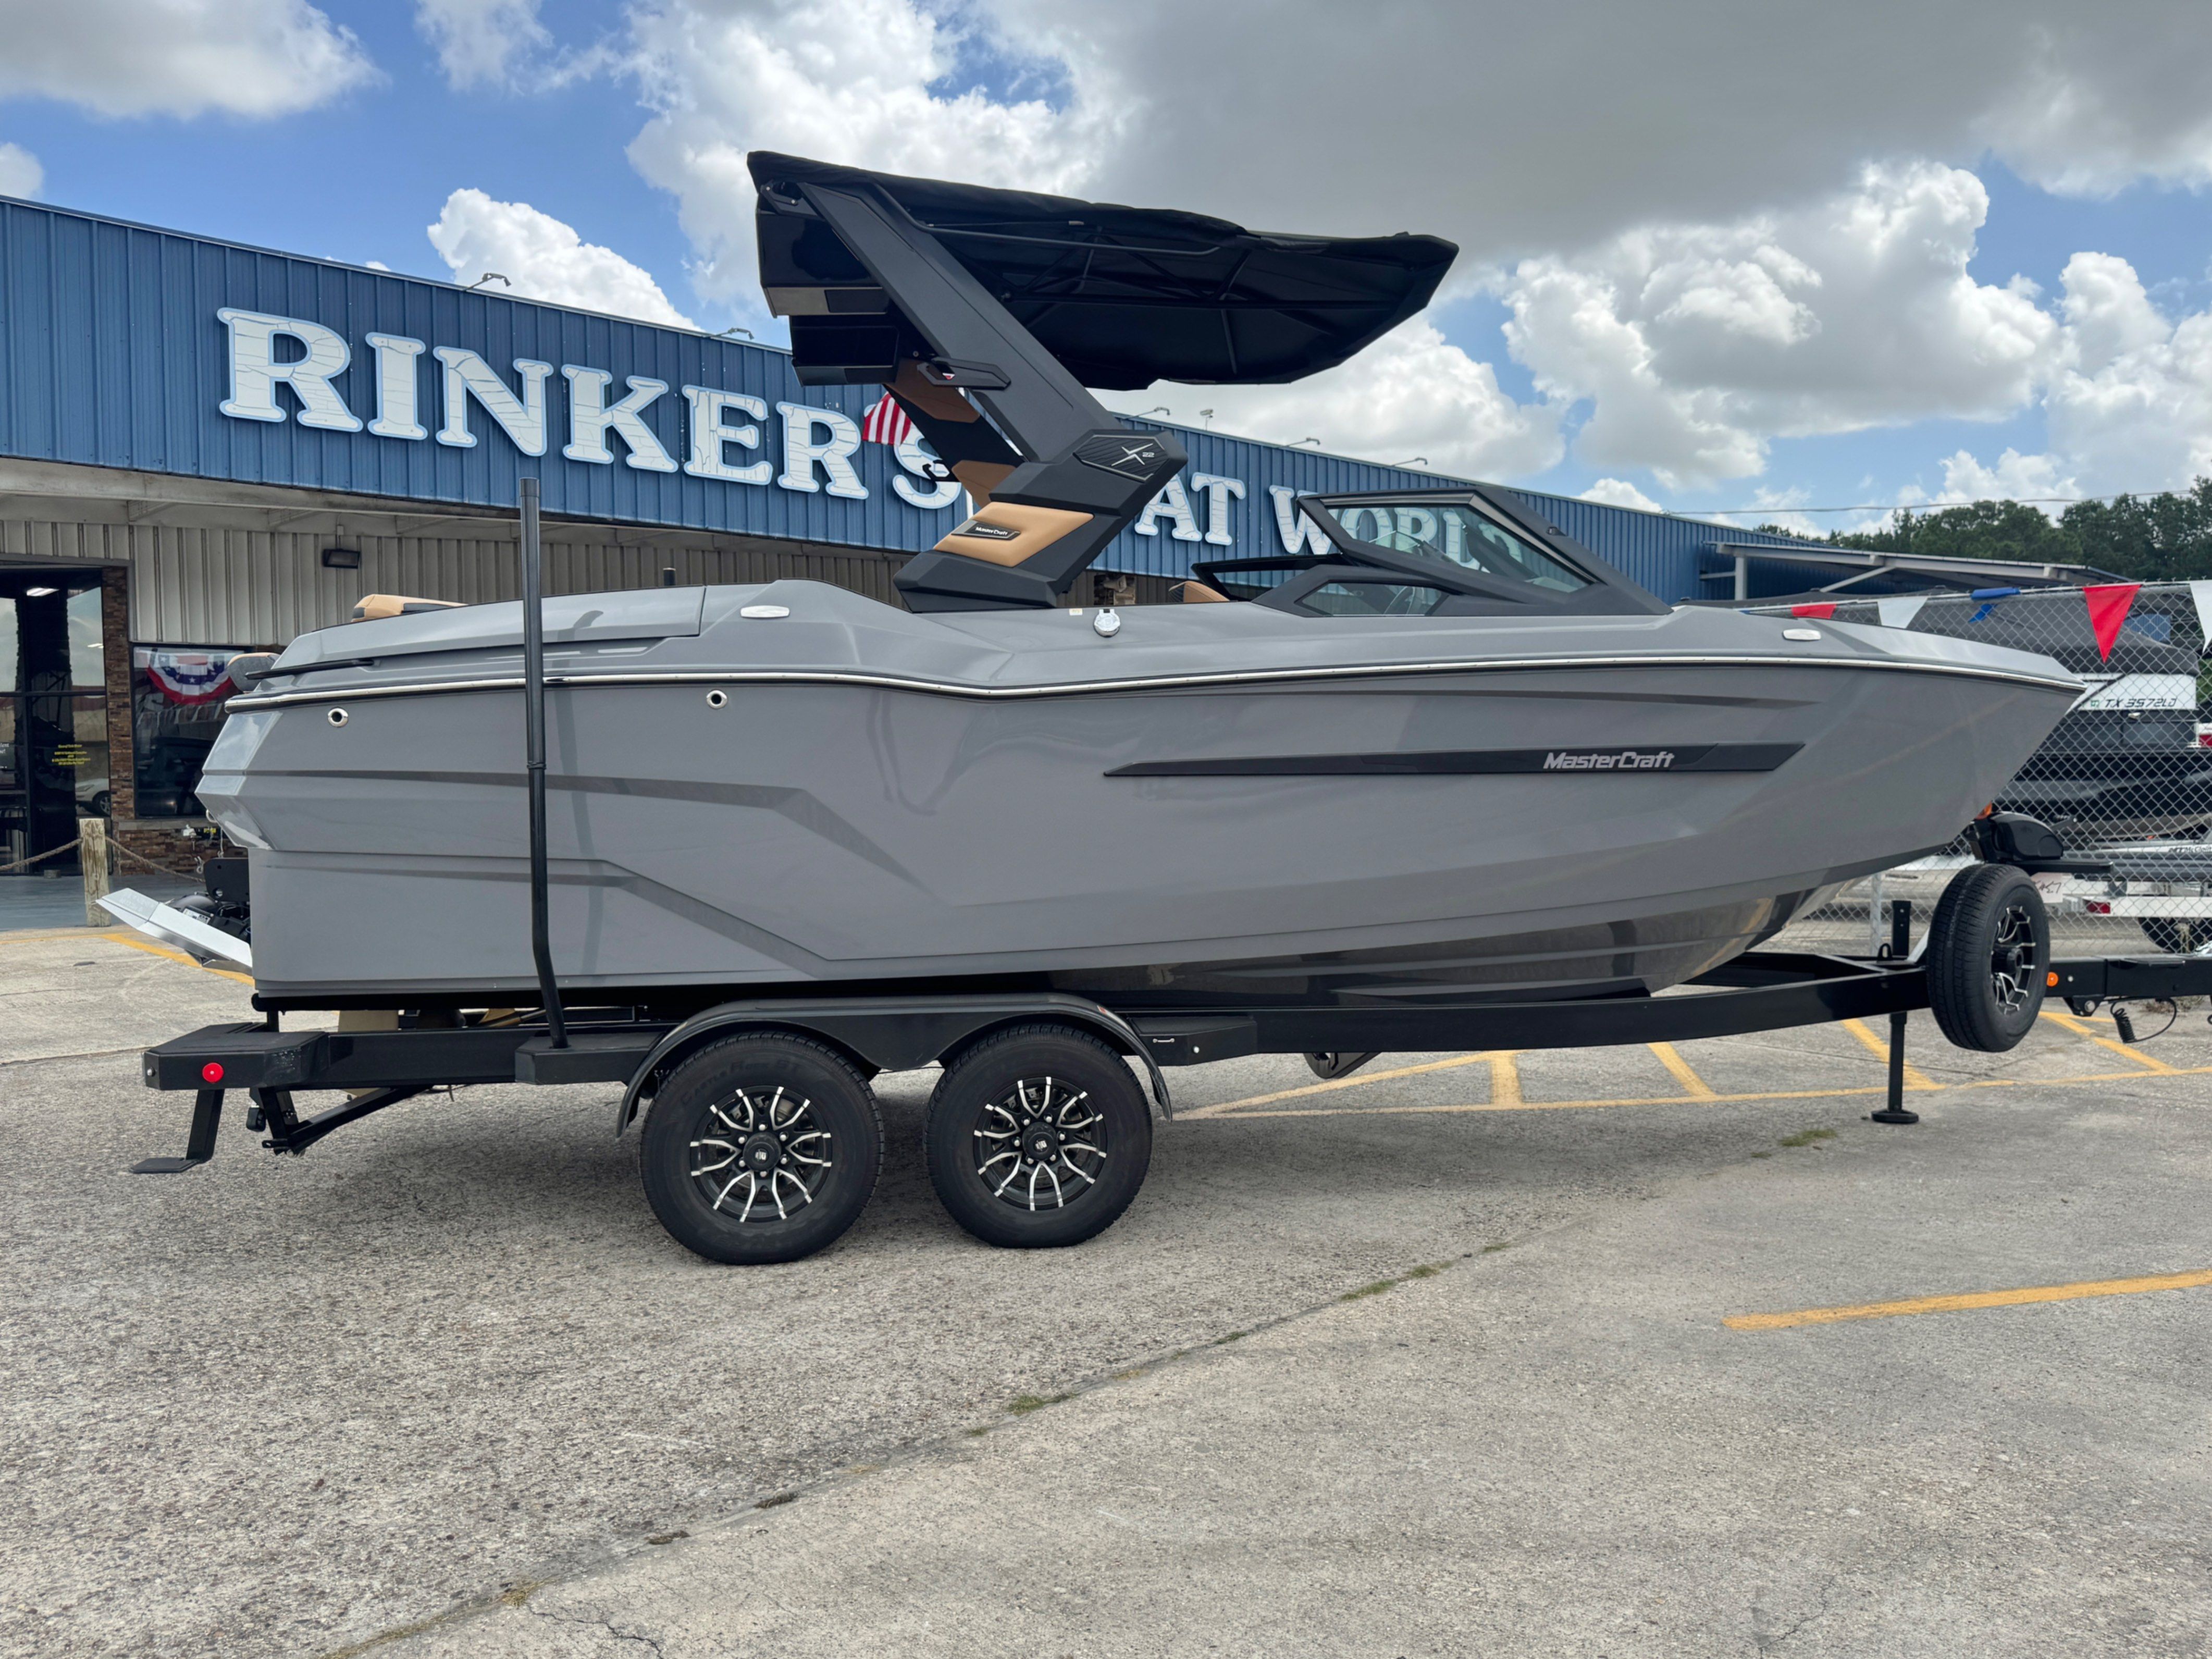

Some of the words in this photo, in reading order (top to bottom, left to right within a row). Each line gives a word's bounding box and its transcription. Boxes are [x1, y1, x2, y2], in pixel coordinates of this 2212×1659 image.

[217, 307, 962, 509] RINKERS
[2105, 699, 2123, 708] TX
[1542, 751, 1675, 769] MasterCraft
